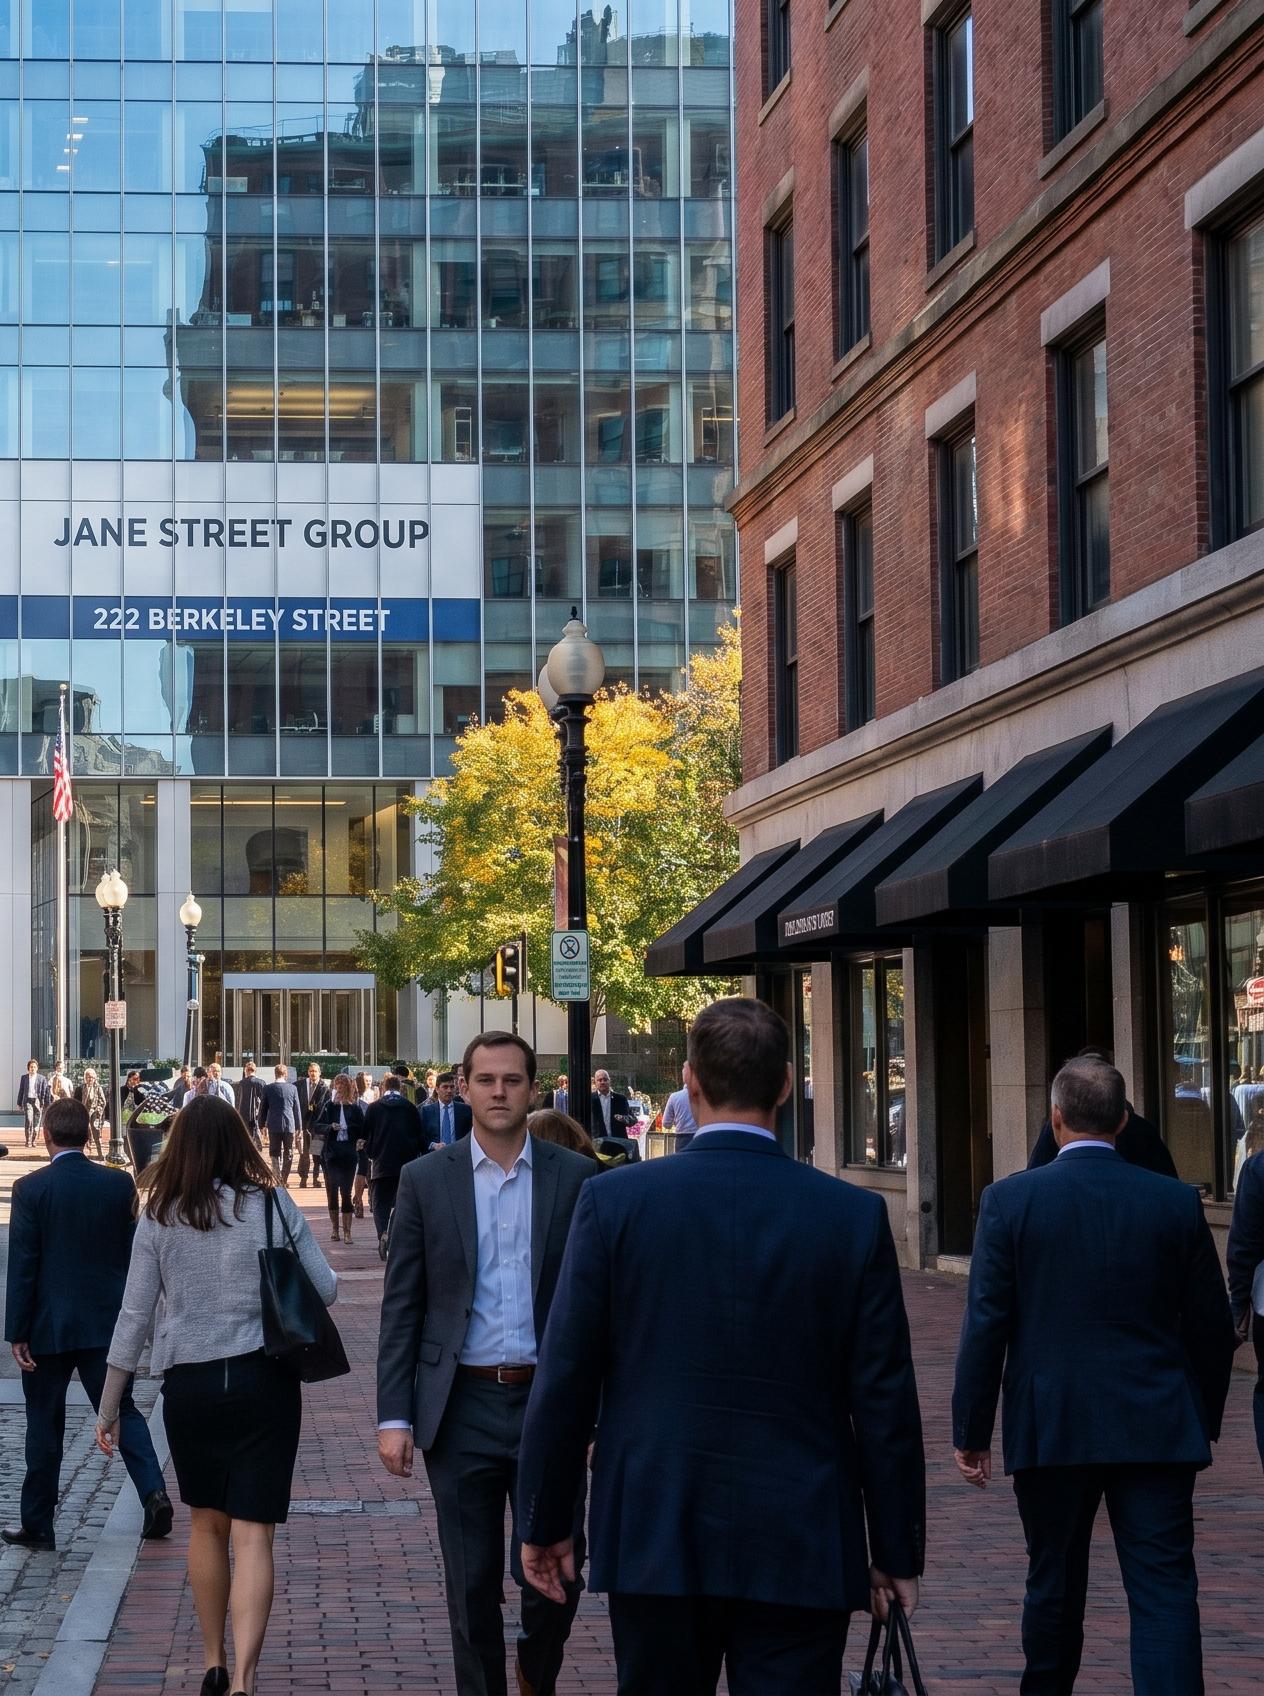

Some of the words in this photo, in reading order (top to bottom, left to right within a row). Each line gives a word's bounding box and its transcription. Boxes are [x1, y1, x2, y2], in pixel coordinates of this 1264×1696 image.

[53, 516, 148, 547] JANE
[158, 517, 293, 549] STREET
[303, 518, 430, 550] GROUP
[93, 607, 140, 630] 222
[149, 607, 285, 632] BERKELEY
[292, 608, 391, 632] STREET
